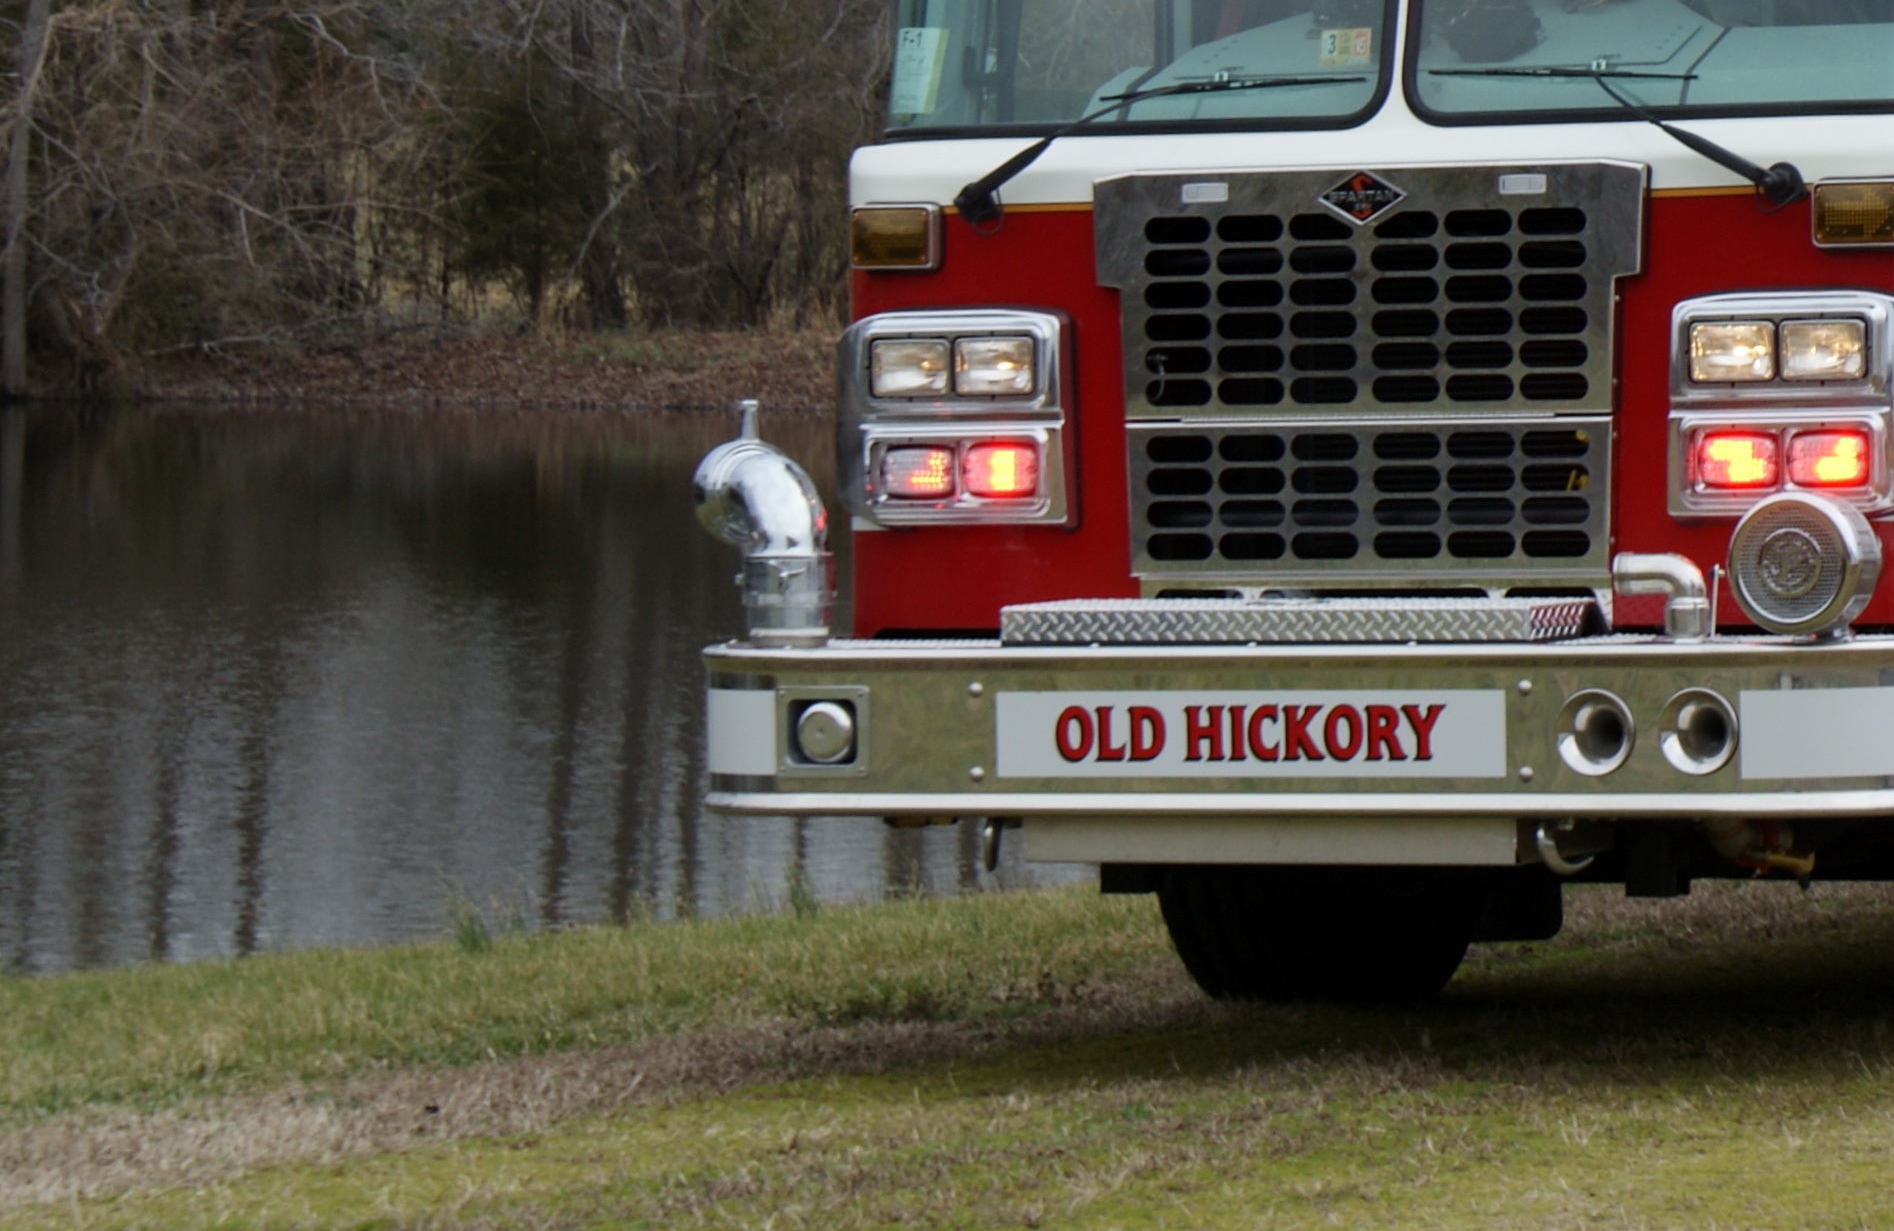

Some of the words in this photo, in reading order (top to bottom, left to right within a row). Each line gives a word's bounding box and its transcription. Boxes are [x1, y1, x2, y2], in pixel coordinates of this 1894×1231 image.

[1328, 33, 1337, 55] 3
[1329, 190, 1395, 203] SPARTAN
[1054, 704, 1167, 763] OLD
[1183, 703, 1448, 763] HICKORY
